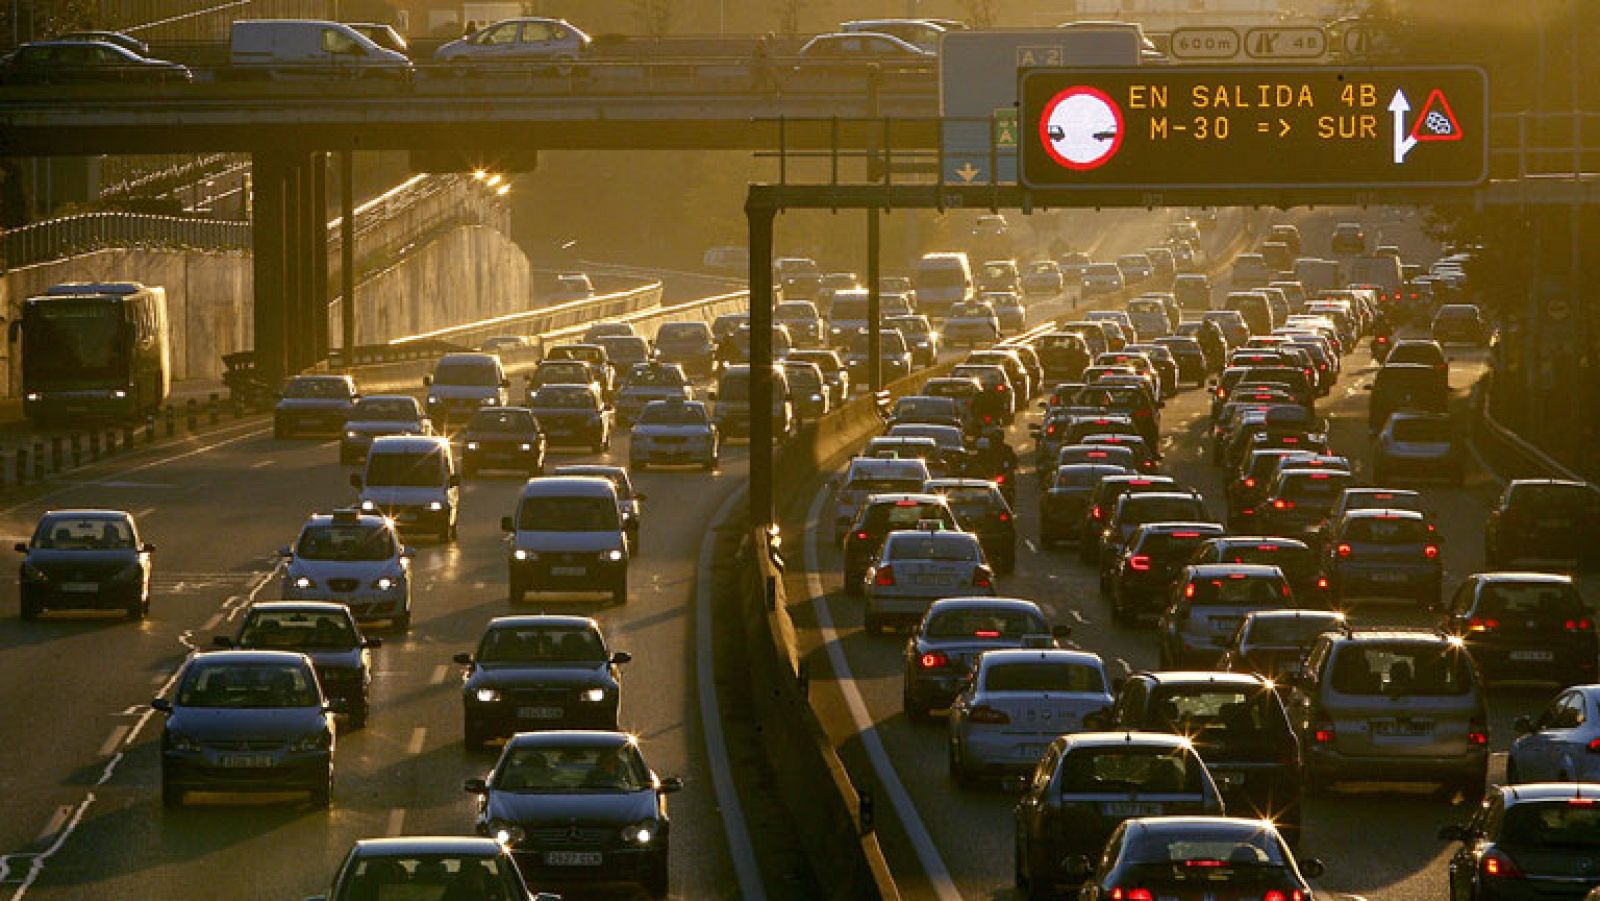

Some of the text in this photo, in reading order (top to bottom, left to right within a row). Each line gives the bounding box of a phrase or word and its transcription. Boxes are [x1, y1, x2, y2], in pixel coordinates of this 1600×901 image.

[1128, 83, 1379, 109] EN SALIDA 4B
[1150, 115, 1230, 140] M-30
[1317, 115, 1377, 139] SUR
